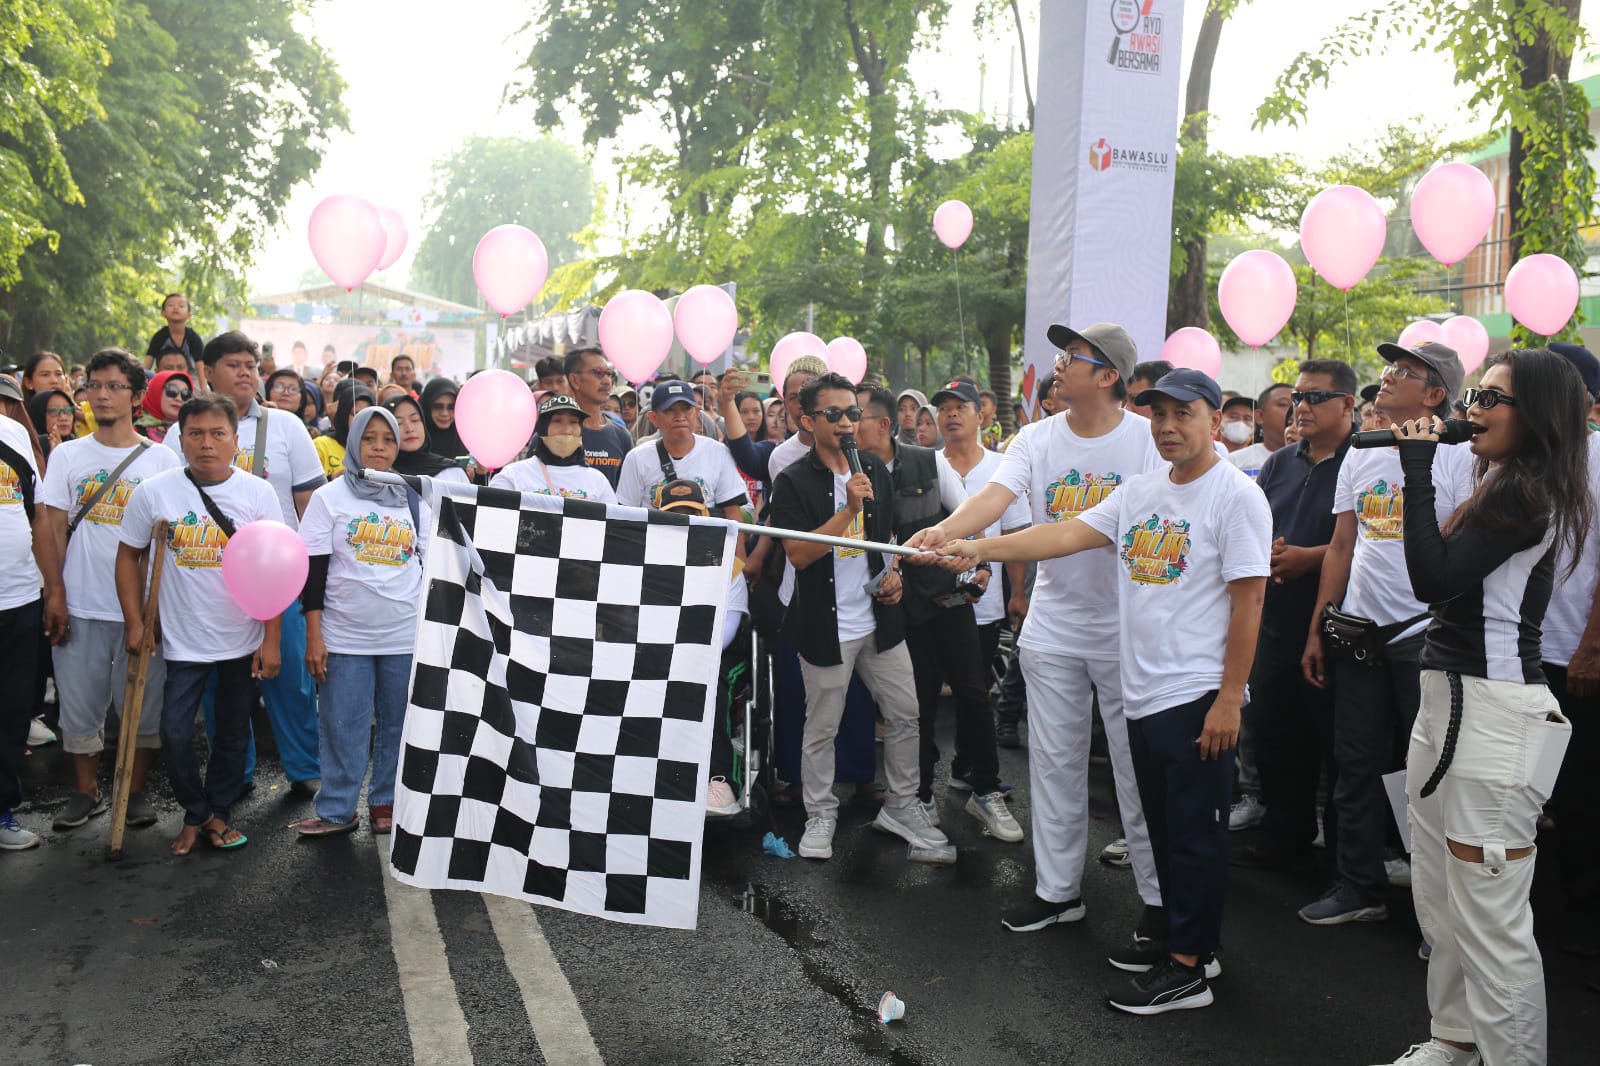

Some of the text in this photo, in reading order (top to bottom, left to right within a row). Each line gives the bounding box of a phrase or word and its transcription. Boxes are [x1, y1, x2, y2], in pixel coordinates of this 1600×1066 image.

[1143, 16, 1162, 35] AYO
[1117, 50, 1160, 72] BERSAMA
[1112, 148, 1168, 164] BAWASLU
[352, 521, 413, 550] JALAN
[360, 543, 399, 560] SEHAT
[1127, 529, 1188, 564] JALAN
[1135, 556, 1169, 577] SEHAT
